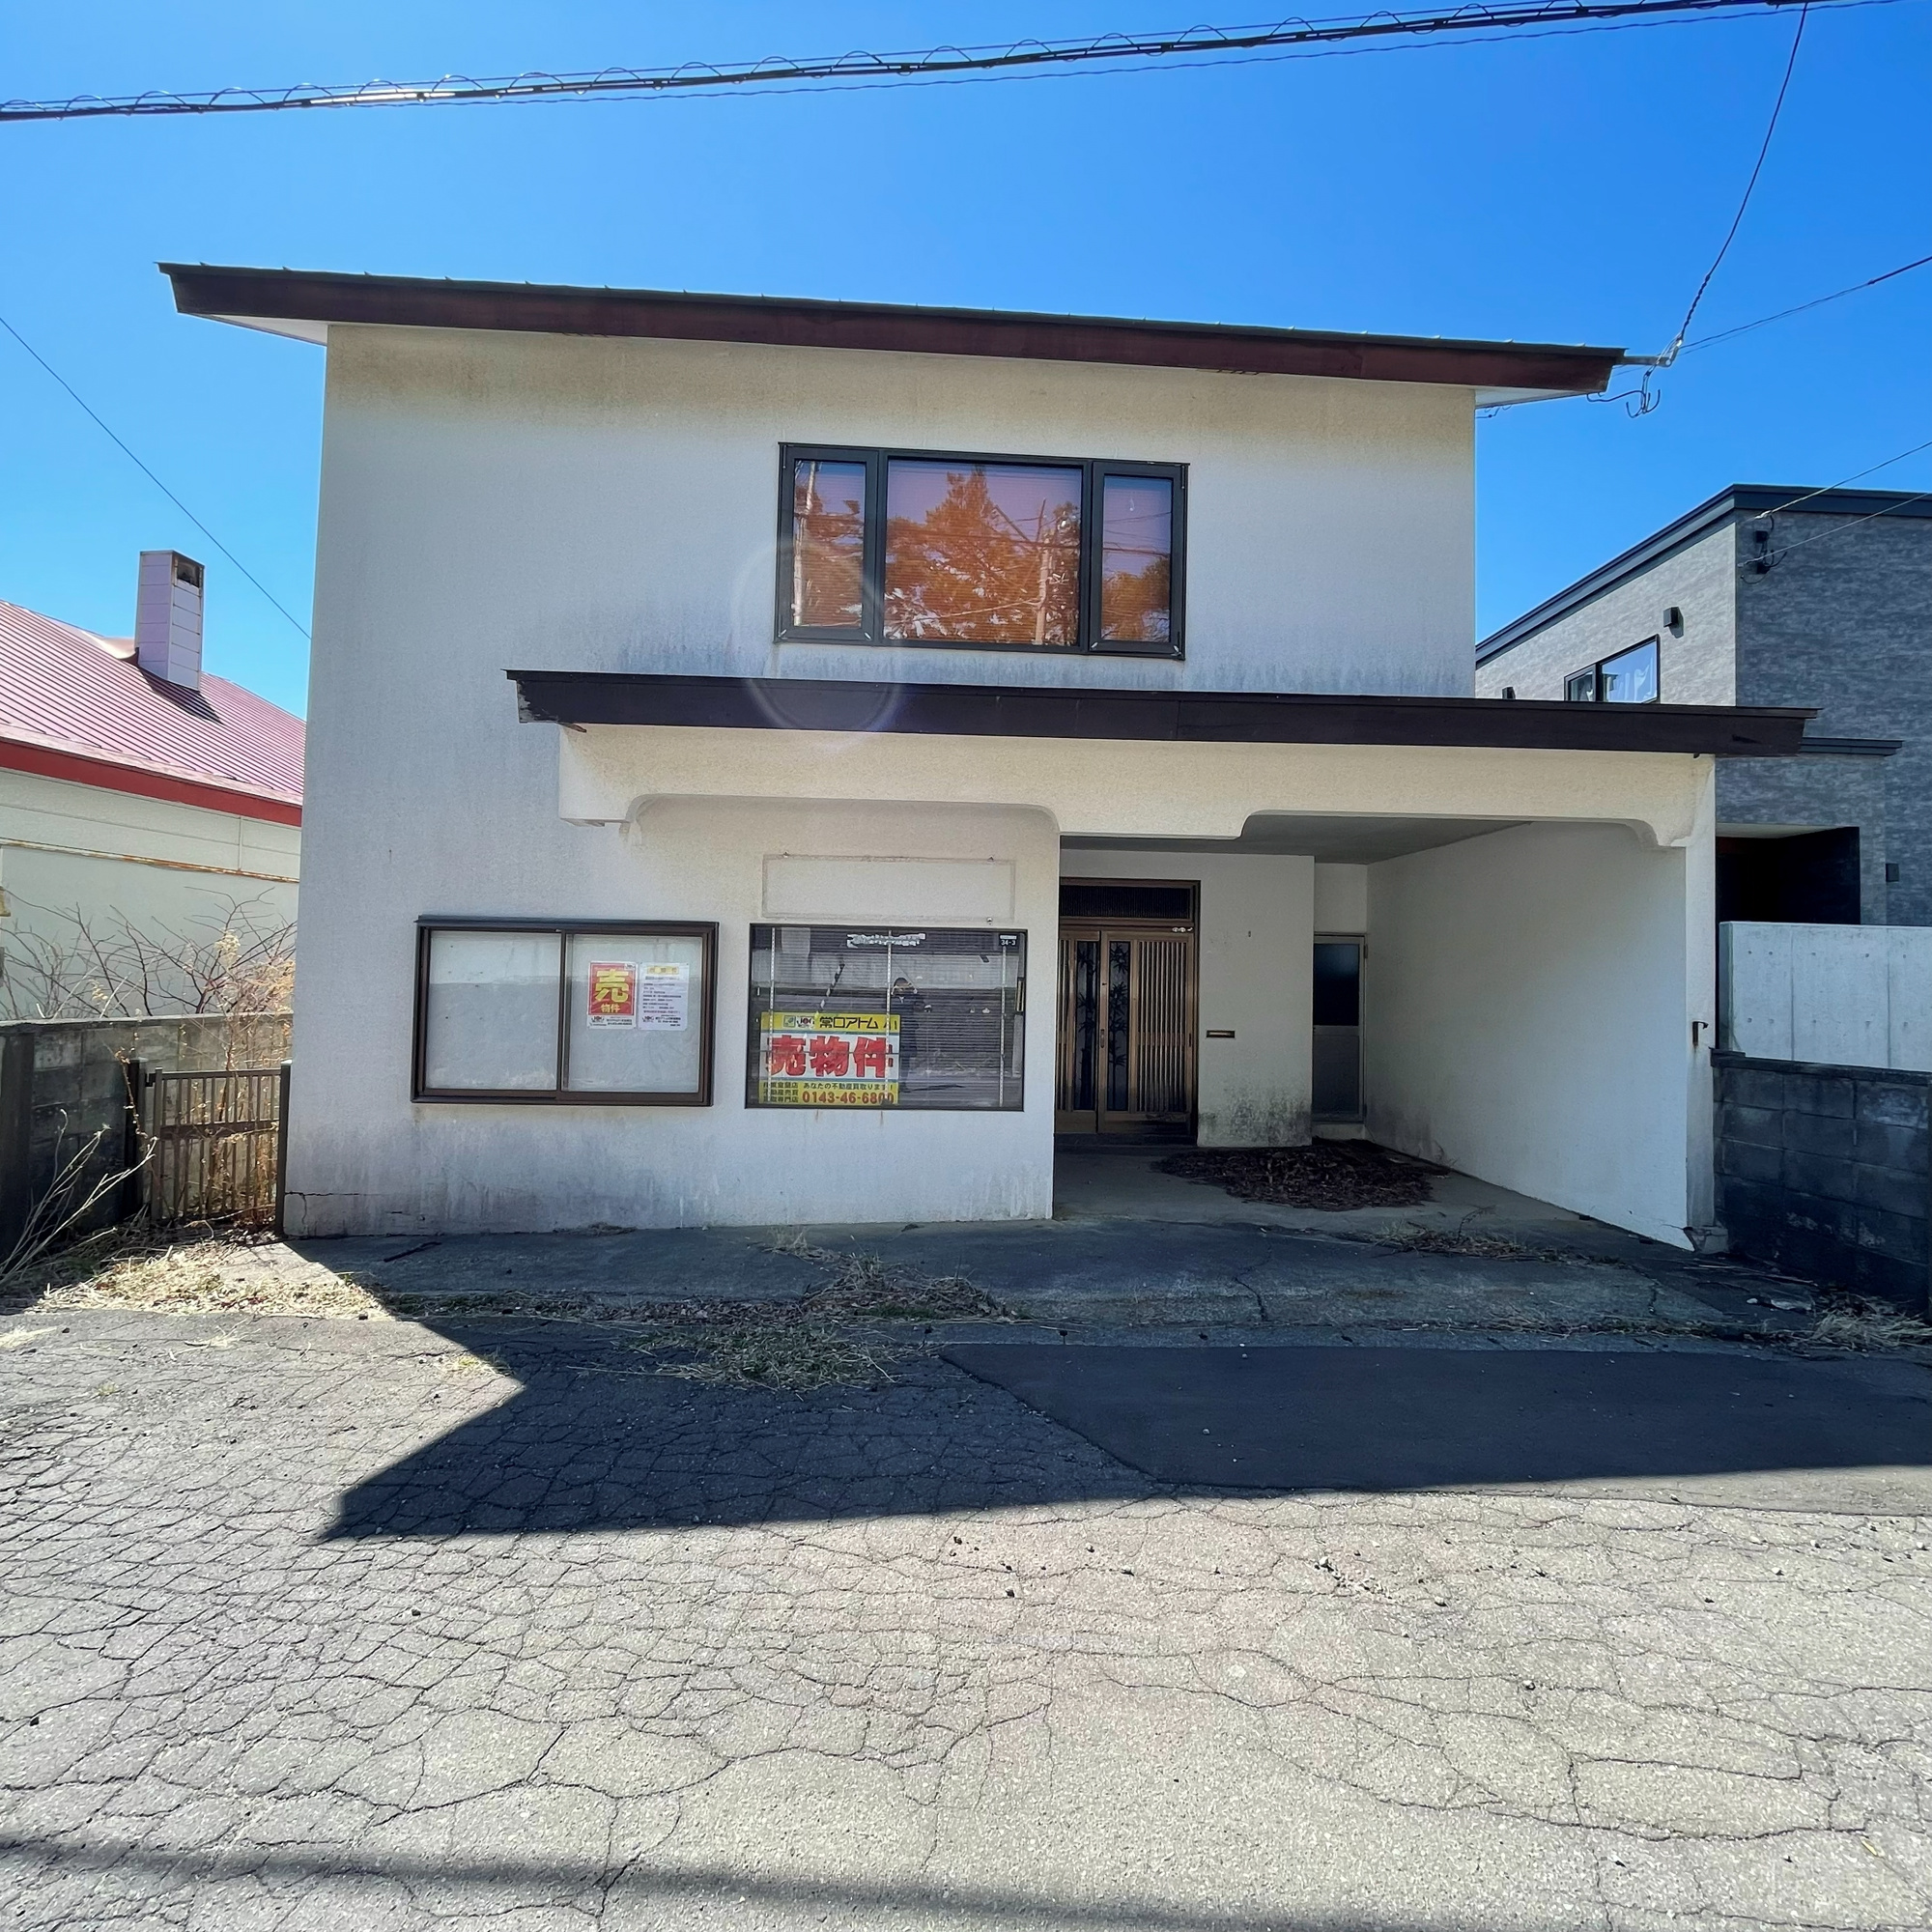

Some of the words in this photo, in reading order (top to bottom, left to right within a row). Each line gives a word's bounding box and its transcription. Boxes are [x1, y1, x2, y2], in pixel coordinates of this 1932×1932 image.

[594, 969, 630, 1003] 売
[601, 1003, 621, 1013] 物件
[819, 1016, 879, 1030] 常口アトム
[766, 1034, 895, 1079] 売物件
